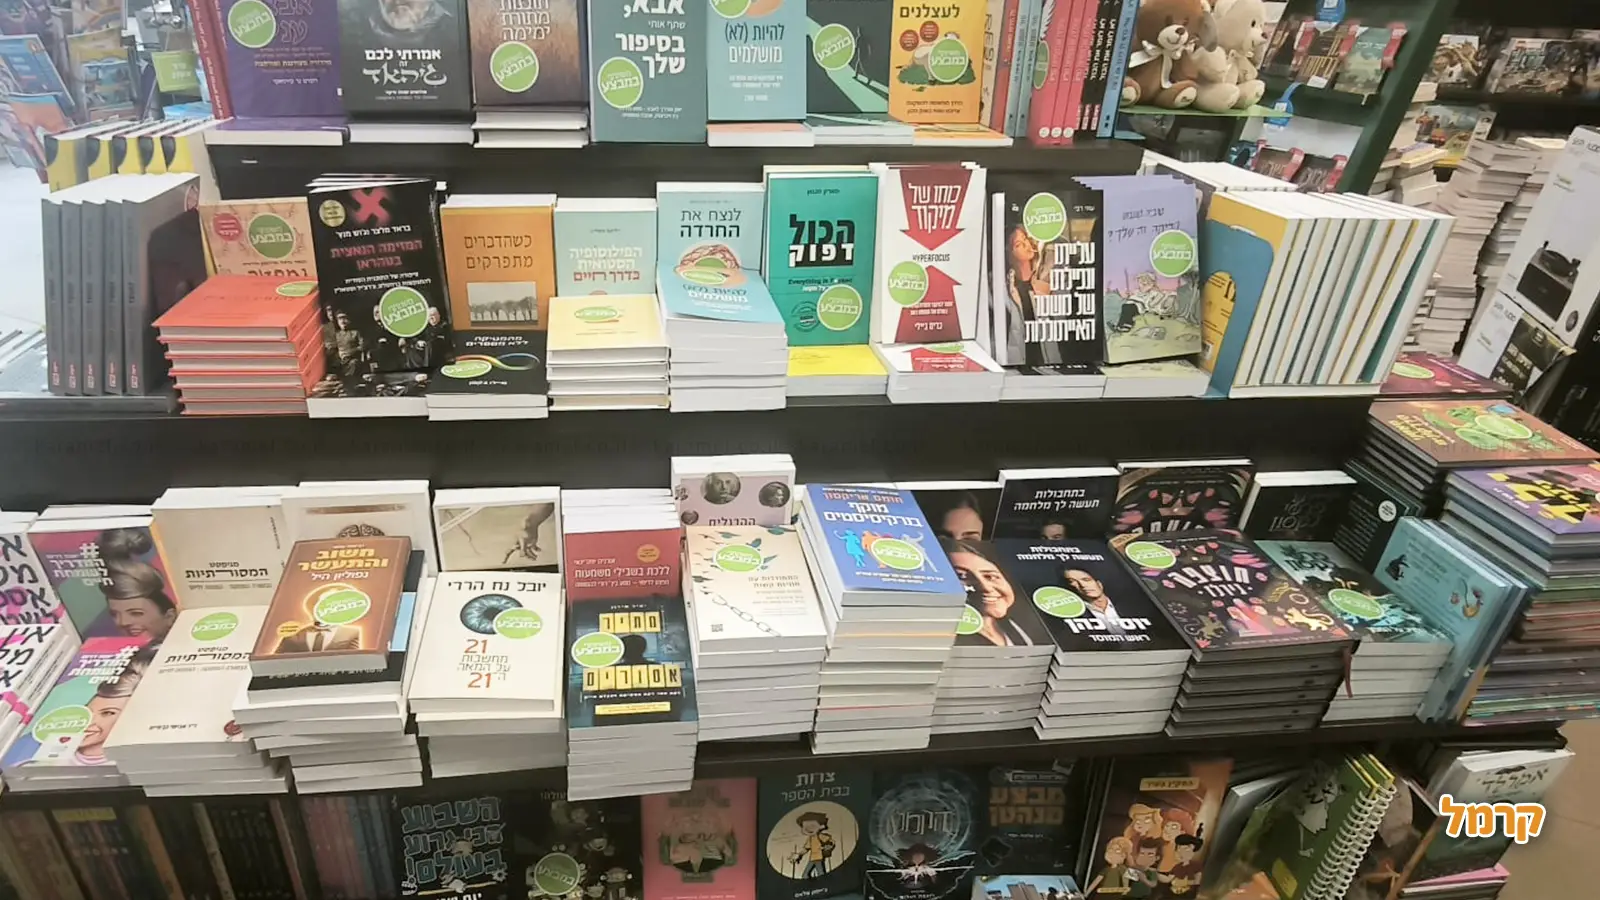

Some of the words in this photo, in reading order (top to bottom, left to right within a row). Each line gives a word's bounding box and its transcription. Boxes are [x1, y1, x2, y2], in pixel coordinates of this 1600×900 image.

[900, 4, 960, 18] לעצלנים
[502, 11, 550, 25] מתורת
[648, 20, 665, 28] אותי
[667, 21, 686, 30] שתף
[753, 22, 785, 41] להיות
[503, 27, 550, 40] ימימה
[725, 22, 749, 44] (לא)
[615, 33, 686, 53] בסיפור
[365, 47, 394, 60] לכם
[396, 49, 441, 60] אמרתי
[729, 45, 783, 63] מושלמים
[642, 53, 686, 79] שלך
[908, 183, 931, 204] של
[934, 185, 961, 204] כוחו
[681, 210, 702, 221] את
[709, 208, 741, 221] לנצח
[912, 205, 956, 234] מיקוד
[1026, 212, 1063, 226] במבצע
[680, 225, 740, 238] החרדה
[789, 214, 855, 246] הכול
[250, 232, 293, 245] במבצע
[464, 235, 532, 249] כשהדברים
[330, 244, 376, 258] הנאצית
[379, 240, 423, 253] המזימה
[569, 244, 642, 259] הפילוסופיה
[789, 243, 854, 267] דפוק
[912, 254, 951, 263] HYPERFOCUS
[1152, 250, 1193, 261] במבצע
[356, 256, 403, 270] בטהראן
[466, 255, 534, 270] מתפרקים
[573, 271, 607, 281] חיים
[889, 279, 925, 291] במבצע
[820, 303, 859, 315] במבצע
[1033, 293, 1073, 317] משטר
[1074, 292, 1096, 316] של
[384, 302, 426, 326] במבצע
[1035, 489, 1085, 499] בתחבולות
[847, 502, 889, 514] מוקף
[1014, 501, 1052, 511] מלחמה
[1054, 500, 1066, 512] לך
[1069, 499, 1100, 509] תעשה
[316, 548, 375, 560] חשוב
[1029, 546, 1081, 554] בתחבולות
[49, 558, 105, 569] המדריך
[1016, 553, 1056, 561] מלחמה
[1056, 554, 1070, 563] לך
[298, 558, 390, 571] והתעשר
[646, 566, 671, 576] ללכת
[574, 567, 612, 579] משמעות
[613, 566, 645, 577] בשבילי
[81, 577, 115, 586] חיים
[448, 580, 485, 591] הררי
[492, 581, 510, 591] נח
[517, 581, 547, 592] יובל
[602, 615, 657, 630] מחיר
[1063, 617, 1107, 634] כהן
[1108, 617, 1153, 630] יוסי
[1088, 634, 1125, 643] המוסד
[1125, 634, 1152, 642] ראש
[464, 638, 489, 654] 21
[461, 654, 509, 664] מחשבות
[457, 663, 491, 672] המאה
[496, 663, 511, 672] על
[586, 668, 678, 687] אסורים
[795, 771, 836, 787] צרות
[781, 789, 816, 801] הספר
[819, 785, 850, 797] בבית
[401, 796, 500, 833] השבוע
[463, 823, 507, 846] הכי
[403, 830, 457, 857] גרוע
